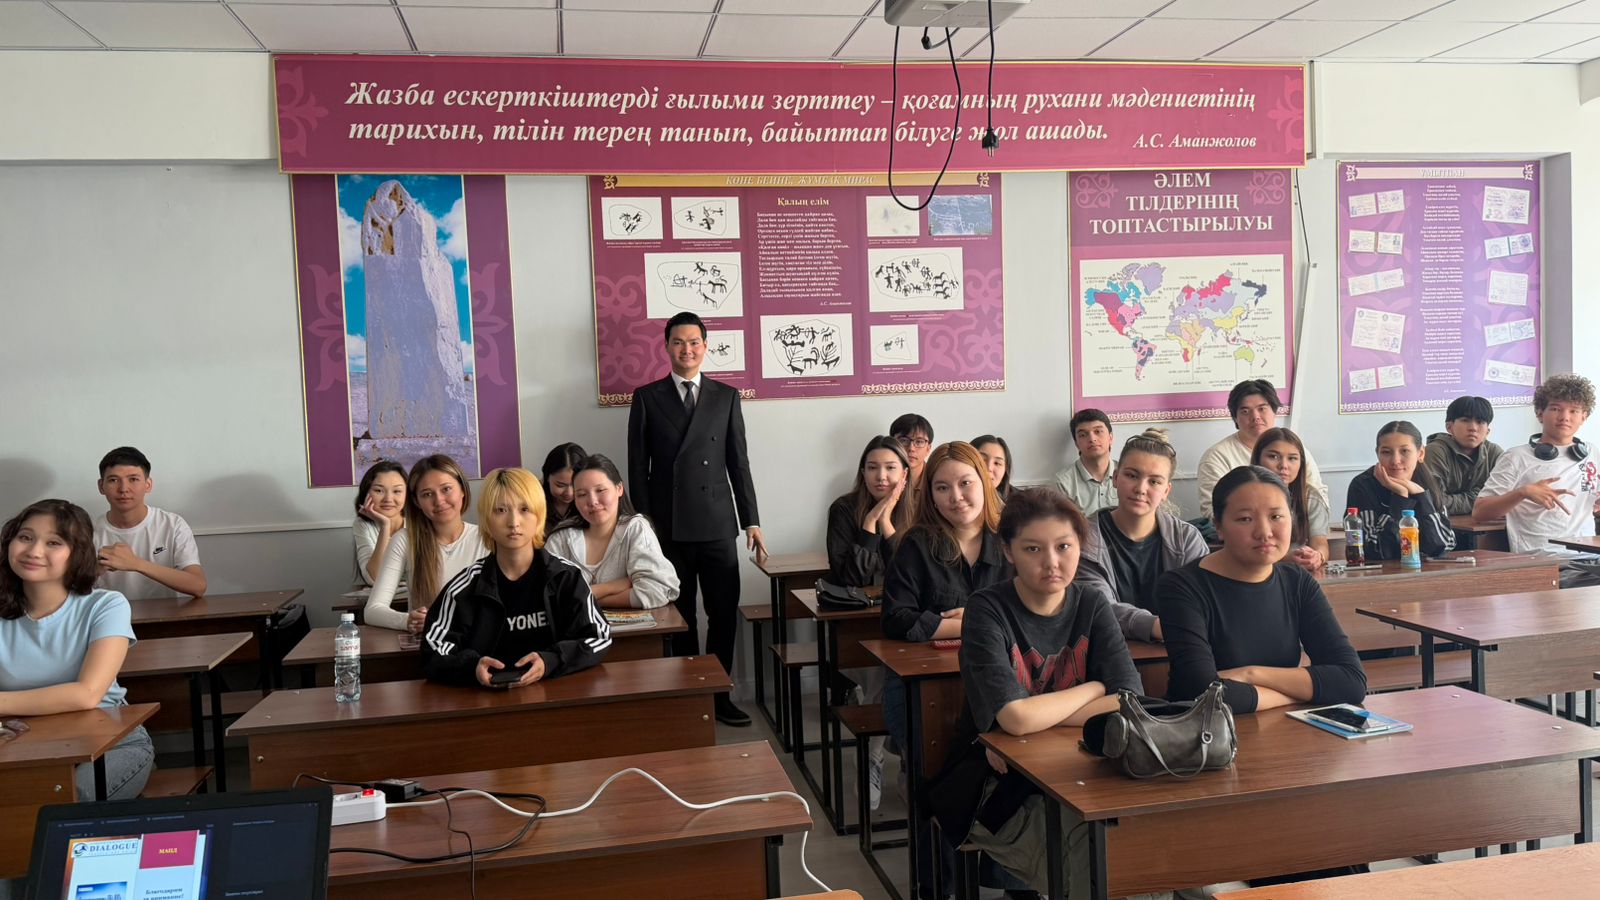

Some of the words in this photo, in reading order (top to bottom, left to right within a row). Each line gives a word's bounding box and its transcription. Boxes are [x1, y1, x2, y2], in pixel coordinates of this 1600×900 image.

[345, 82, 435, 106] Жазба
[443, 85, 659, 114] ескерткіштерді
[664, 92, 765, 110] ғылыми
[772, 94, 875, 116] зерттеу
[902, 93, 1018, 115] қоғамның
[1022, 93, 1103, 115] рухани
[1107, 88, 1256, 112] мәдениетінің
[348, 122, 484, 145] тарихын,
[492, 119, 565, 141] тілін
[573, 126, 652, 147] терең
[659, 126, 753, 146] танып,
[761, 121, 888, 143] байыптап
[894, 120, 963, 148] білуге
[1025, 120, 1108, 140] ашады.
[1132, 133, 1164, 148] А.С.
[1168, 134, 1257, 149] Аманжолов
[1154, 172, 1210, 189] ӘЛЕМ
[777, 197, 808, 207] Қалың
[810, 197, 829, 206] елім
[1125, 194, 1240, 213] ТІЛДЕРІНІҢ
[1089, 215, 1273, 235] ТОПТАСТЫРЫЛУЫ
[507, 611, 550, 631] YONE
[89, 842, 137, 852] DIALOGUE
